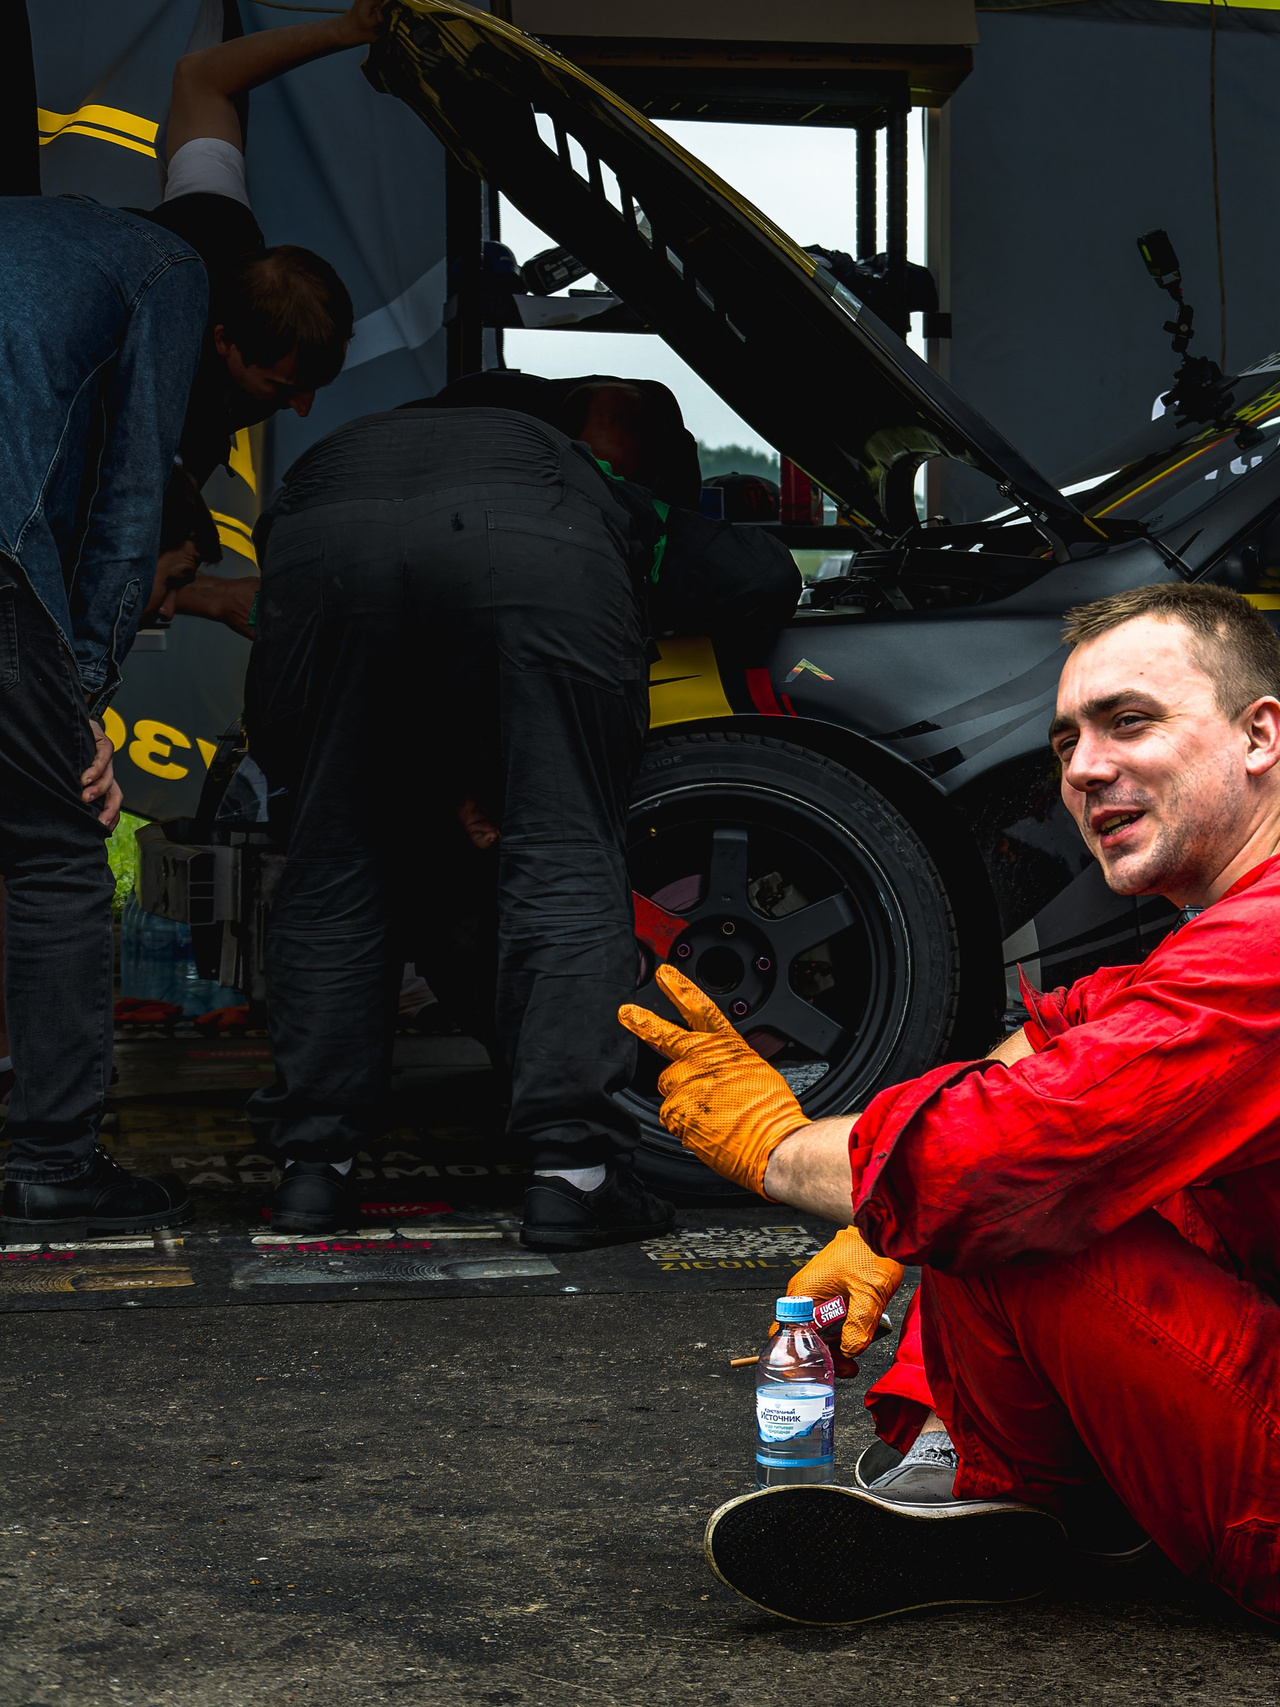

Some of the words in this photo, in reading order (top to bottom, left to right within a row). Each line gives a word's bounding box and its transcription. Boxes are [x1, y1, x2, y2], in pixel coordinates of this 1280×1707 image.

[657, 1259, 809, 1271] ZICOIL.R
[820, 1298, 841, 1314] LUCKY
[821, 1306, 845, 1323] STRIKE
